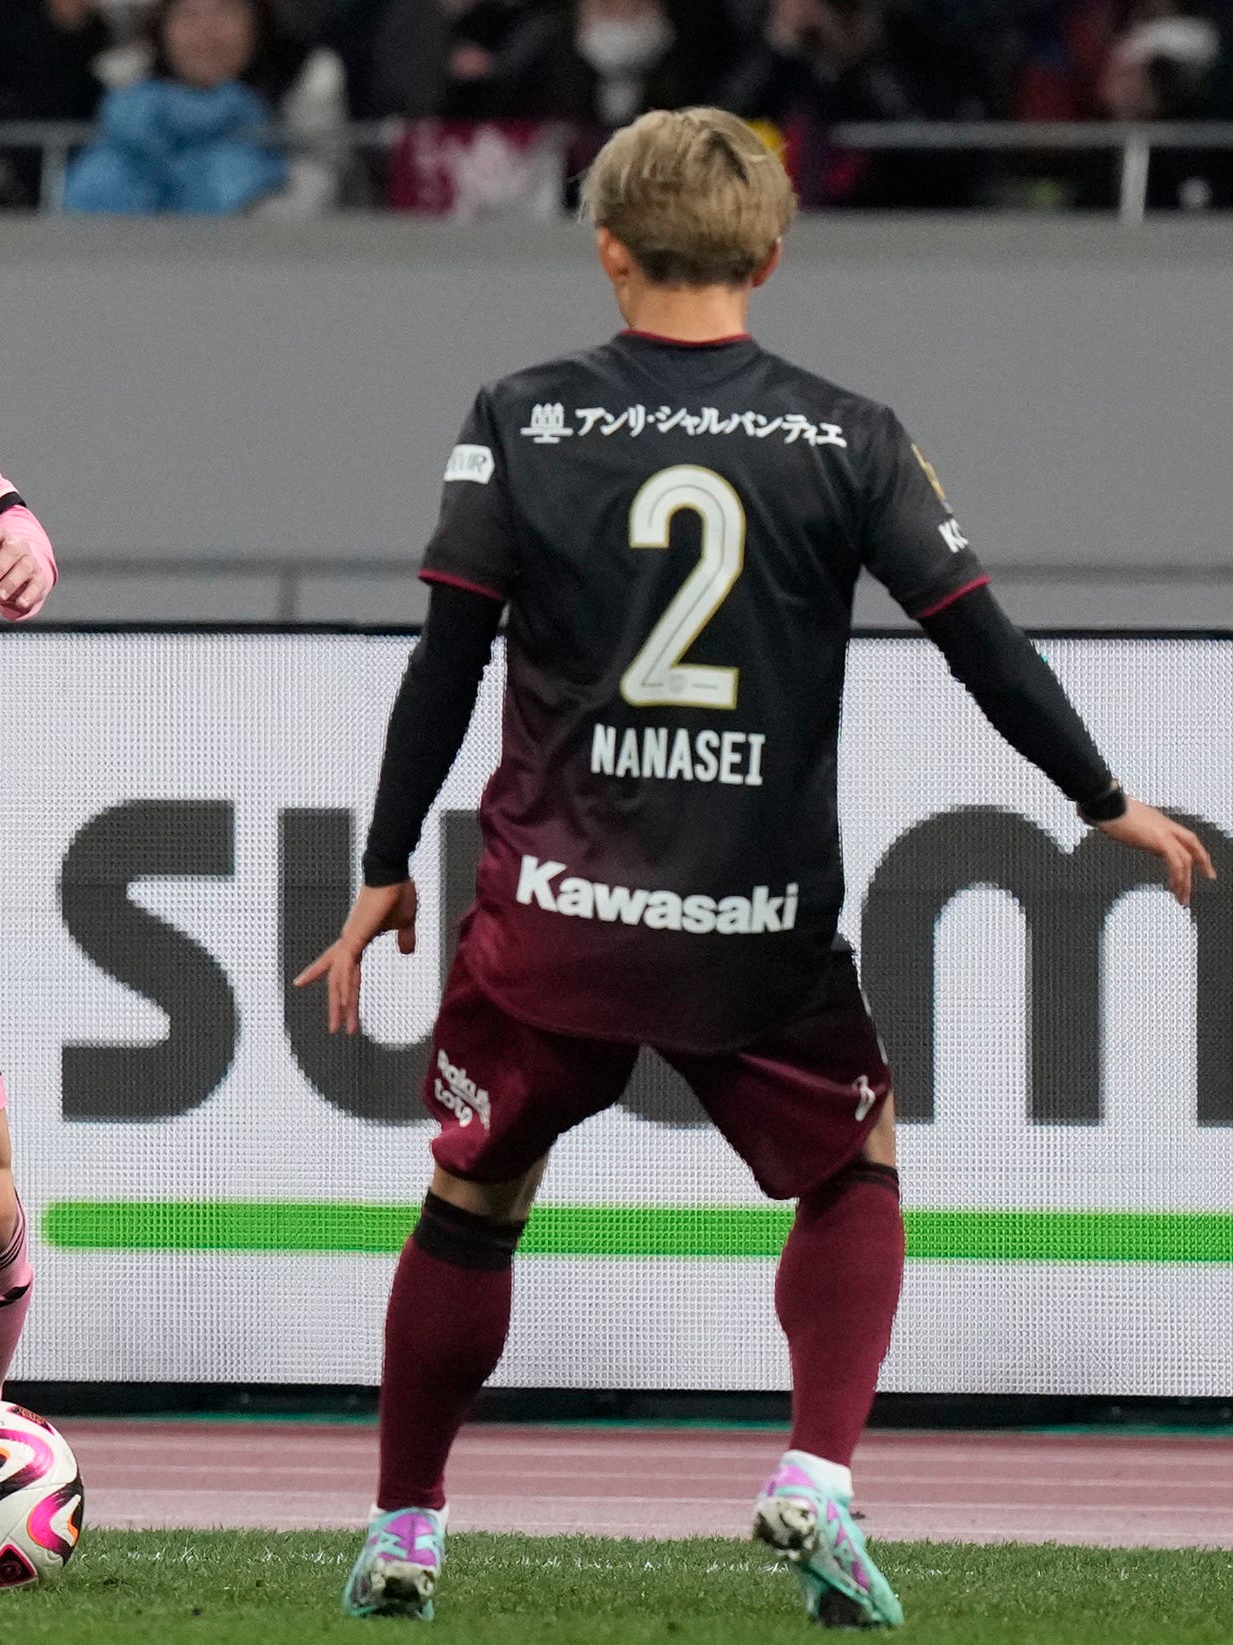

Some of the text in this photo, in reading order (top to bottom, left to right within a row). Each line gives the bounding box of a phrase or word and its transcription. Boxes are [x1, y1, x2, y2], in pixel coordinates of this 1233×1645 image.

[619, 463, 747, 710] 2
[590, 722, 766, 786] NANASEI
[516, 854, 799, 935] Kawasaki
